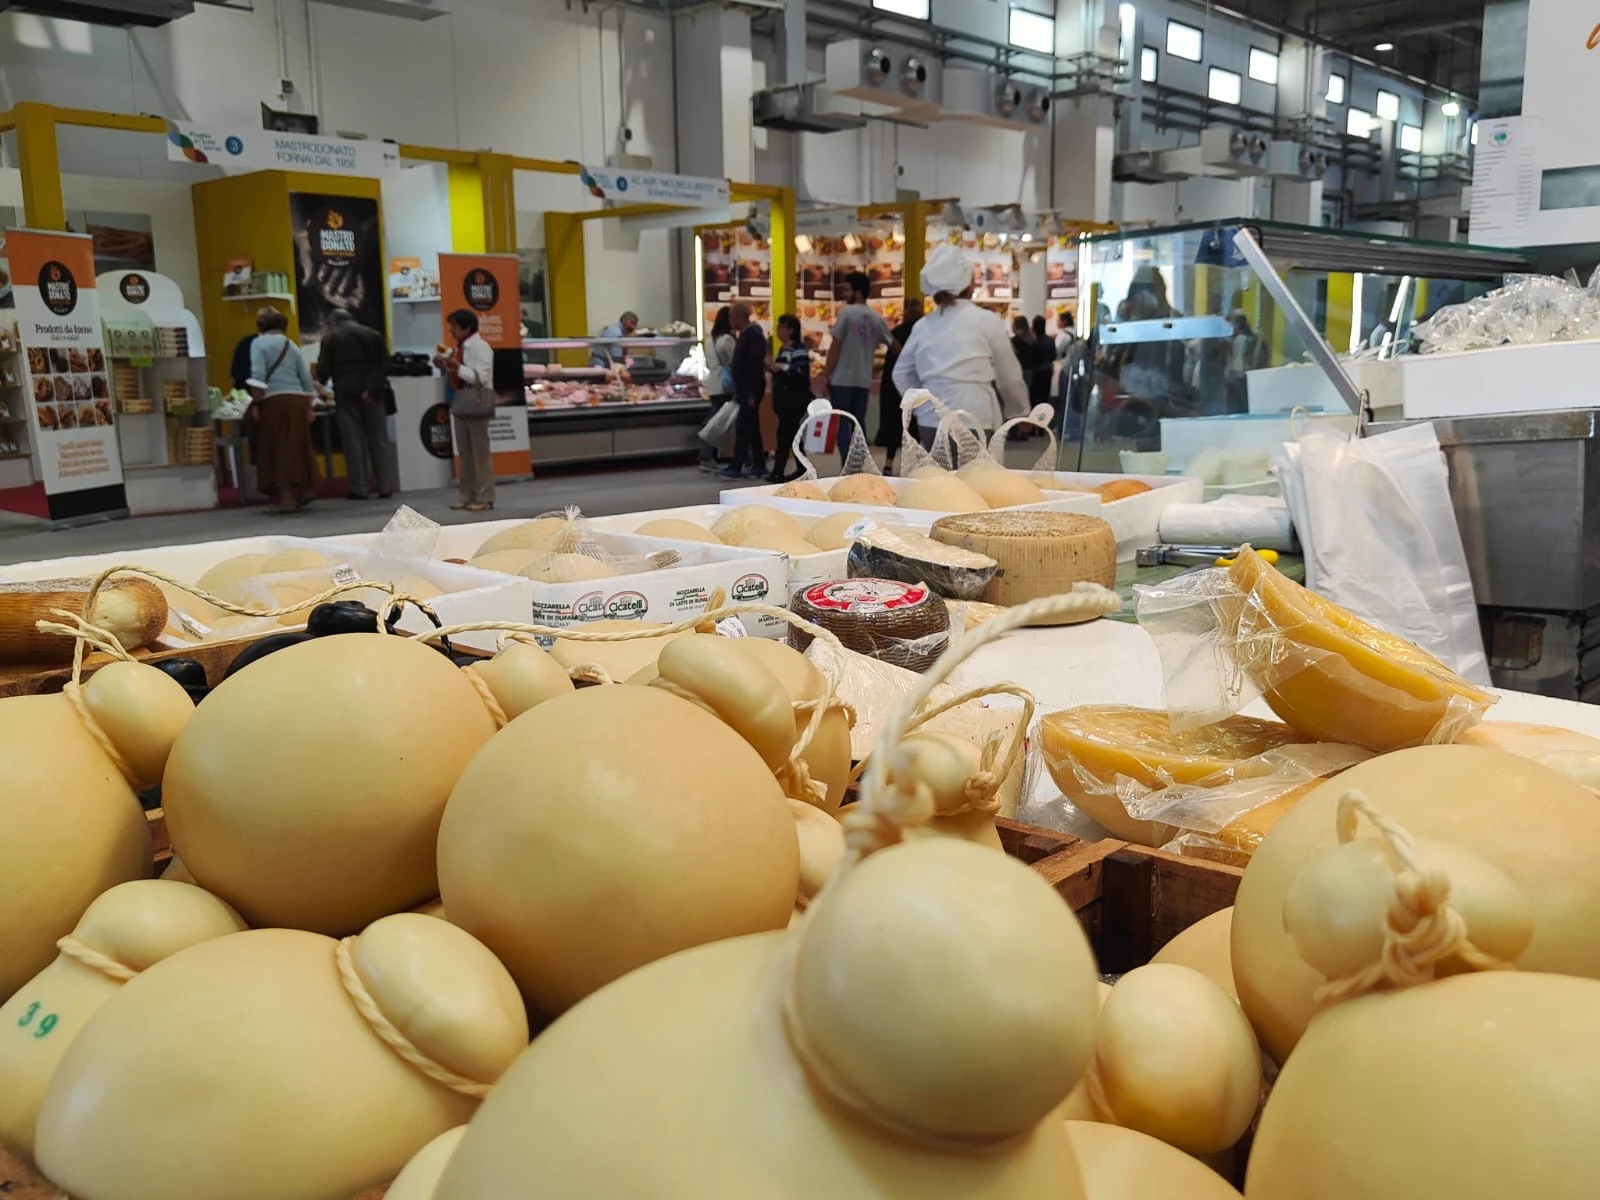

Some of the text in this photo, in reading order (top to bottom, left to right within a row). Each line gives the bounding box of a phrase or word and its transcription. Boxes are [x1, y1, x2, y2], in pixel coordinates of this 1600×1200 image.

[275, 139, 356, 157] MASTRODONATO
[277, 151, 312, 165] FORNAI
[320, 229, 355, 241] MASTRO
[320, 240, 356, 252] DONATO
[35, 323, 93, 334] Prodotti da forno
[676, 587, 705, 596] MOZZARELLA
[736, 582, 765, 594] Cicatelli
[609, 599, 642, 613] Cicatelli
